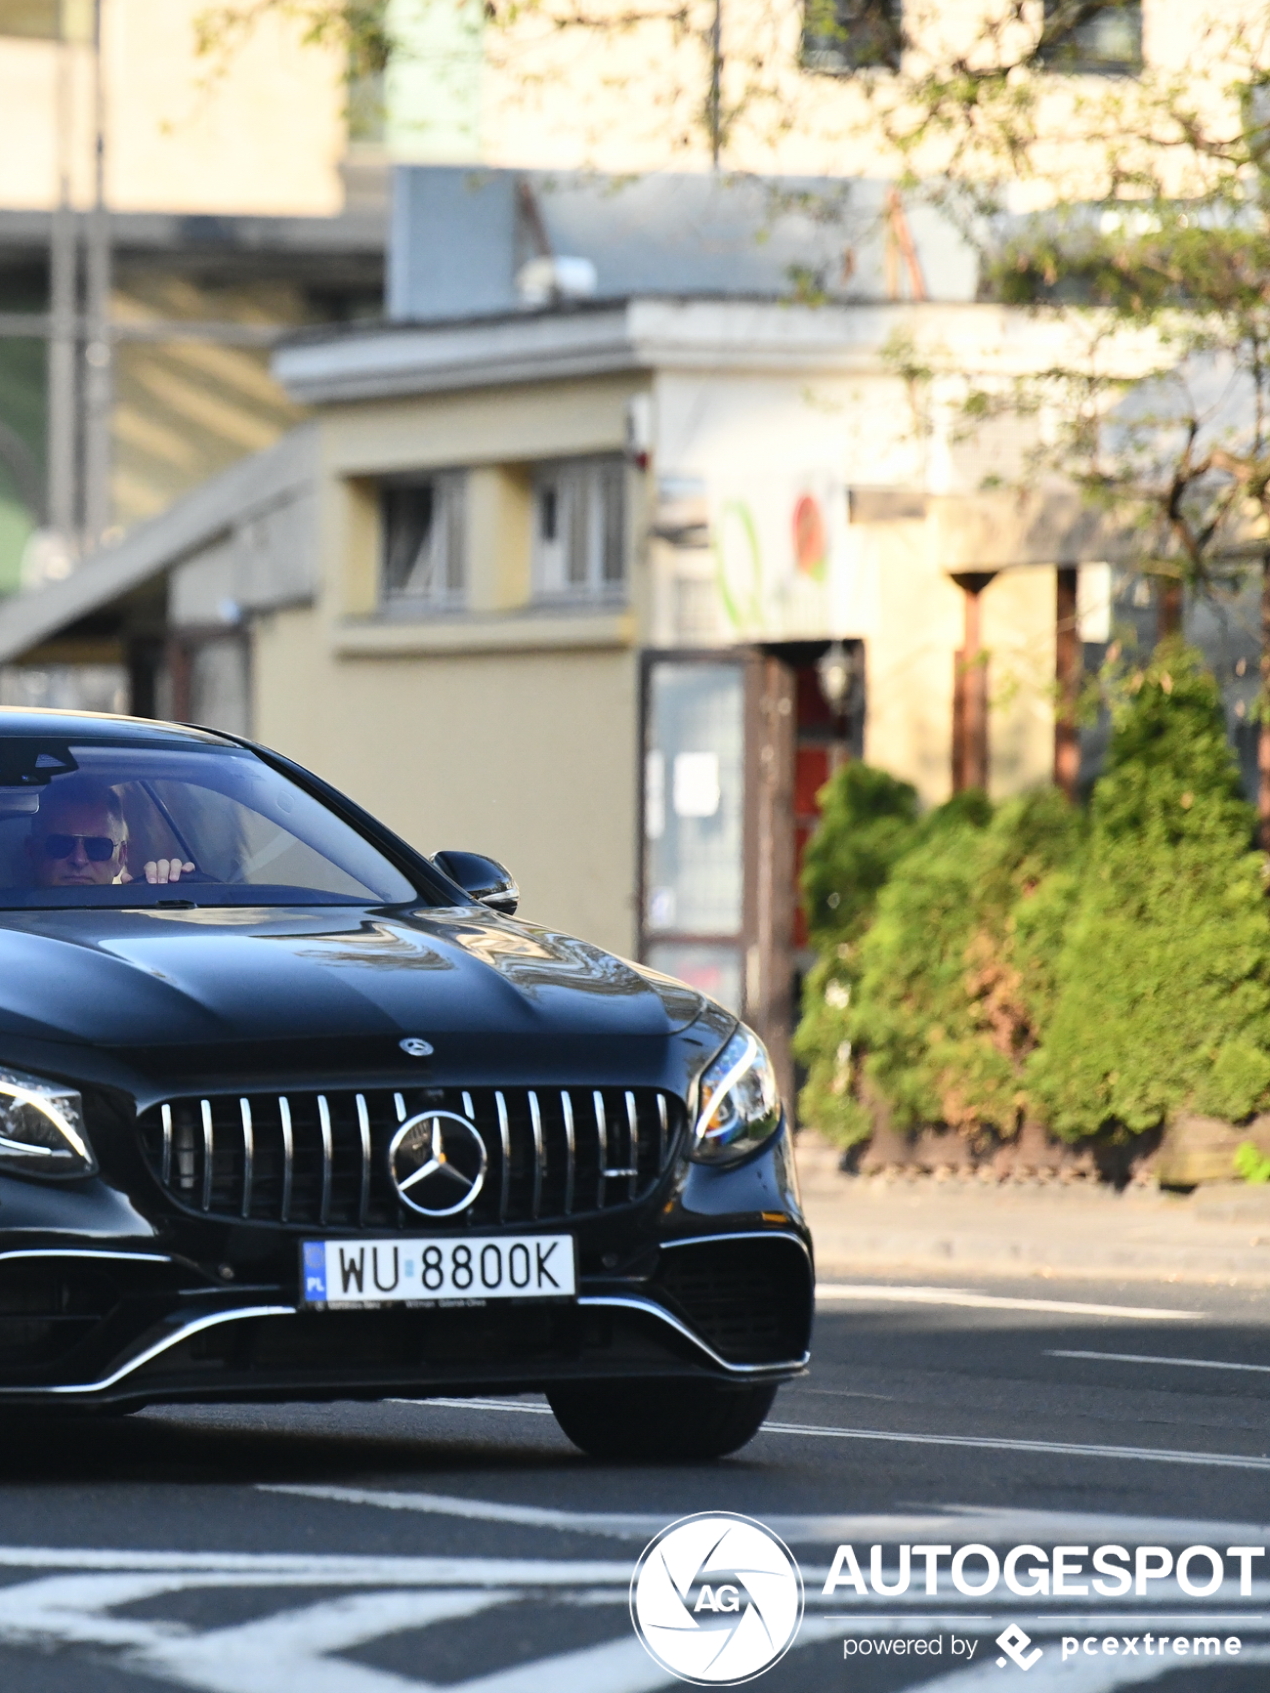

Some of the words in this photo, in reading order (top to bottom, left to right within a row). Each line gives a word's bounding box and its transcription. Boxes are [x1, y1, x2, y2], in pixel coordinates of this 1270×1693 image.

[339, 1246, 399, 1293] WU
[422, 1241, 560, 1291] 8800K
[307, 1277, 324, 1292] PL
